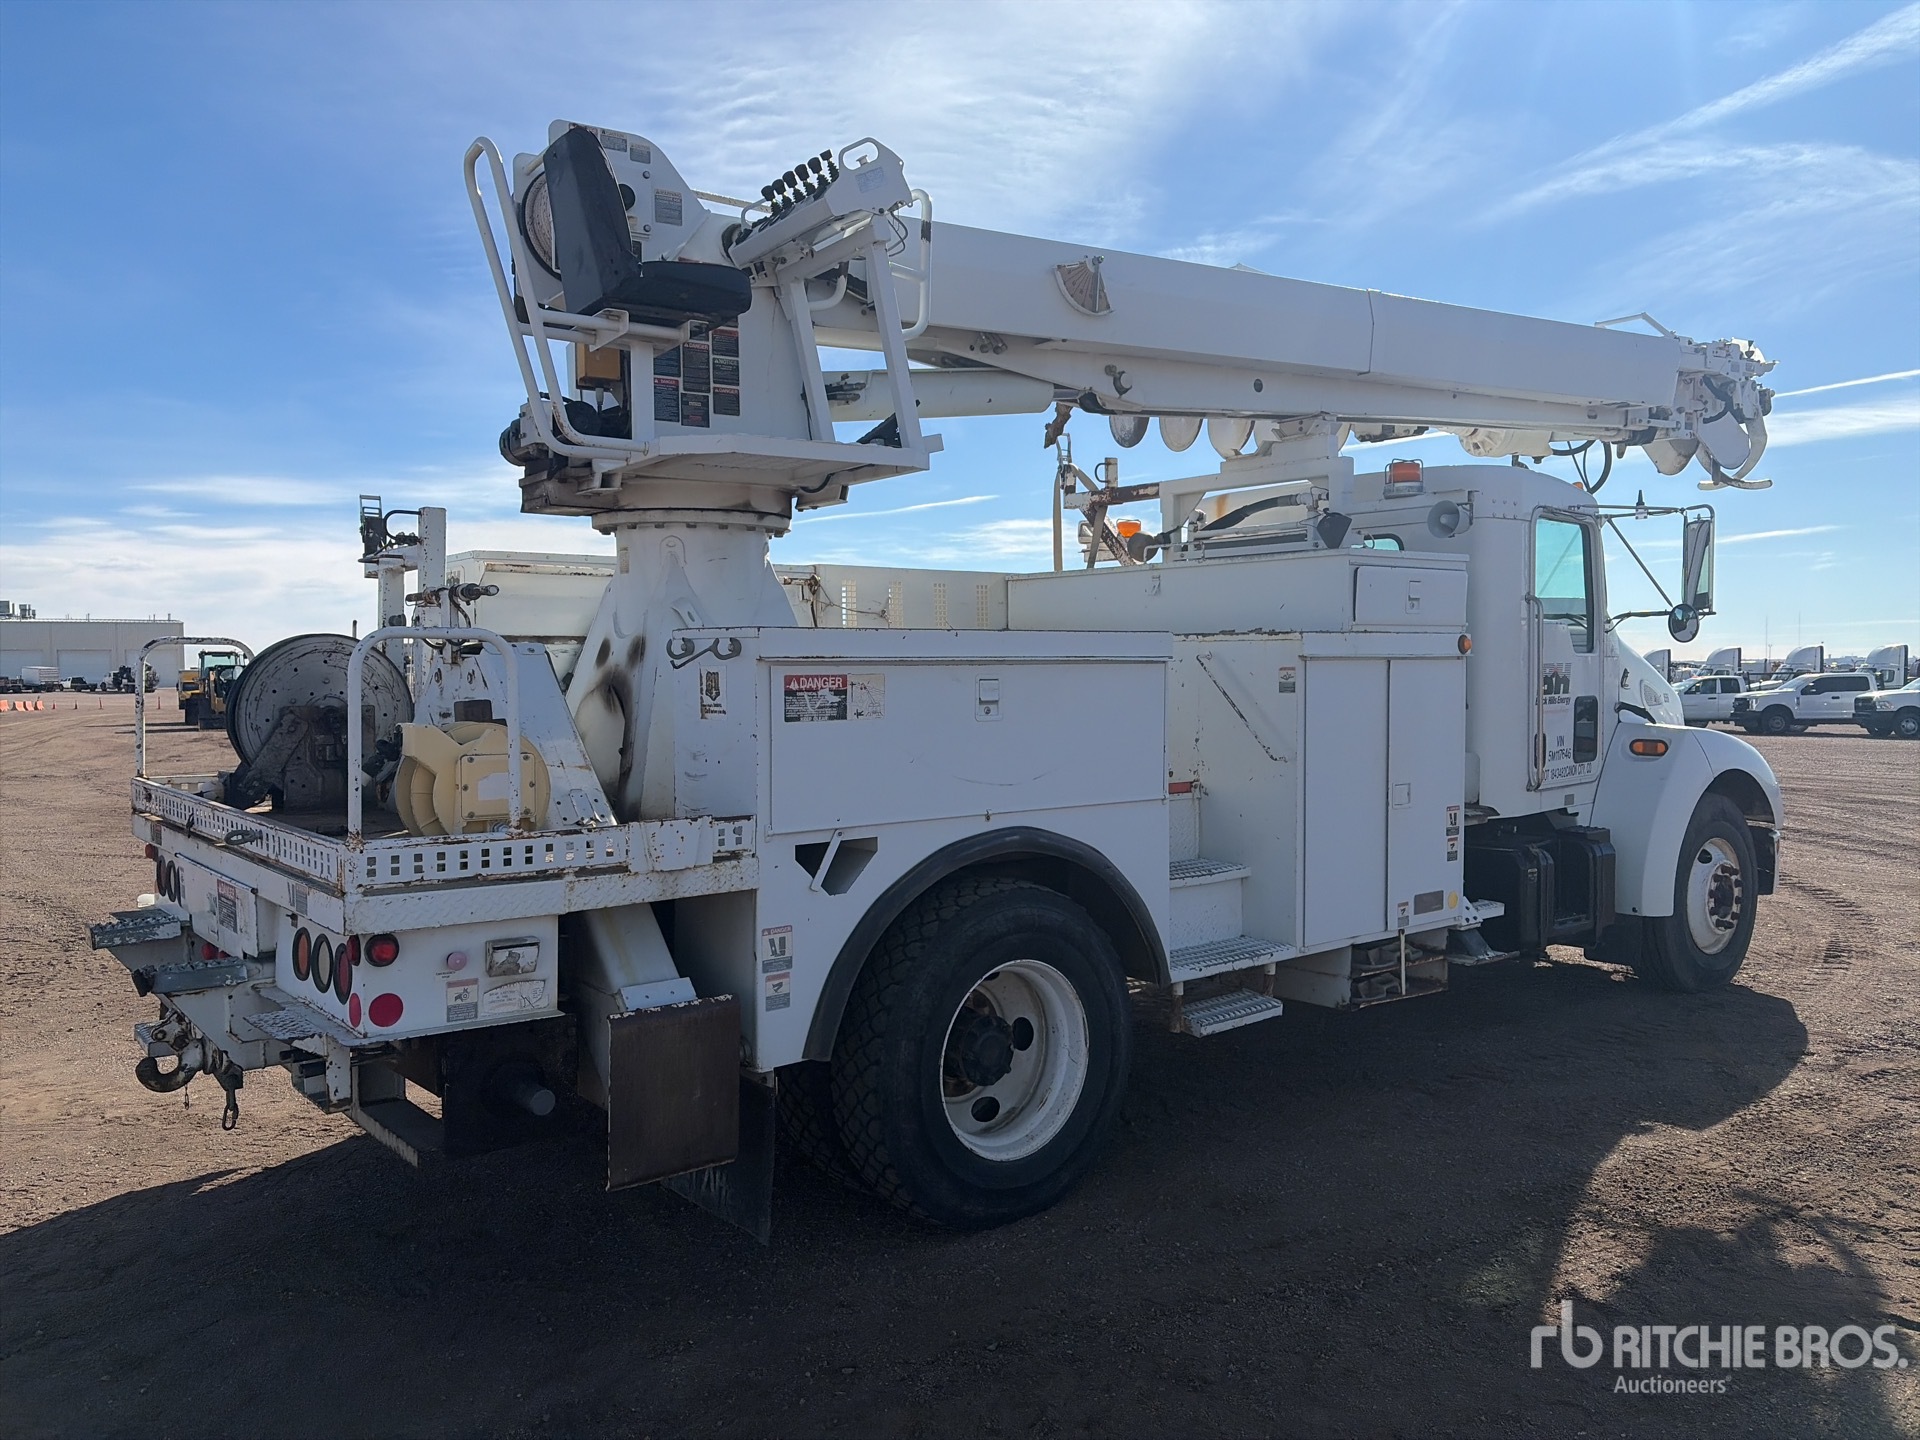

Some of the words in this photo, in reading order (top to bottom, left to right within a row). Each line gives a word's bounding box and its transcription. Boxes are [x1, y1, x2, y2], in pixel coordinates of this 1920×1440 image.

[689, 342, 708, 350] DANGER
[718, 388, 738, 396] DANGER
[800, 677, 842, 689] DANGER
[1556, 735, 1565, 747] VIN
[770, 926, 791, 935] DANGER
